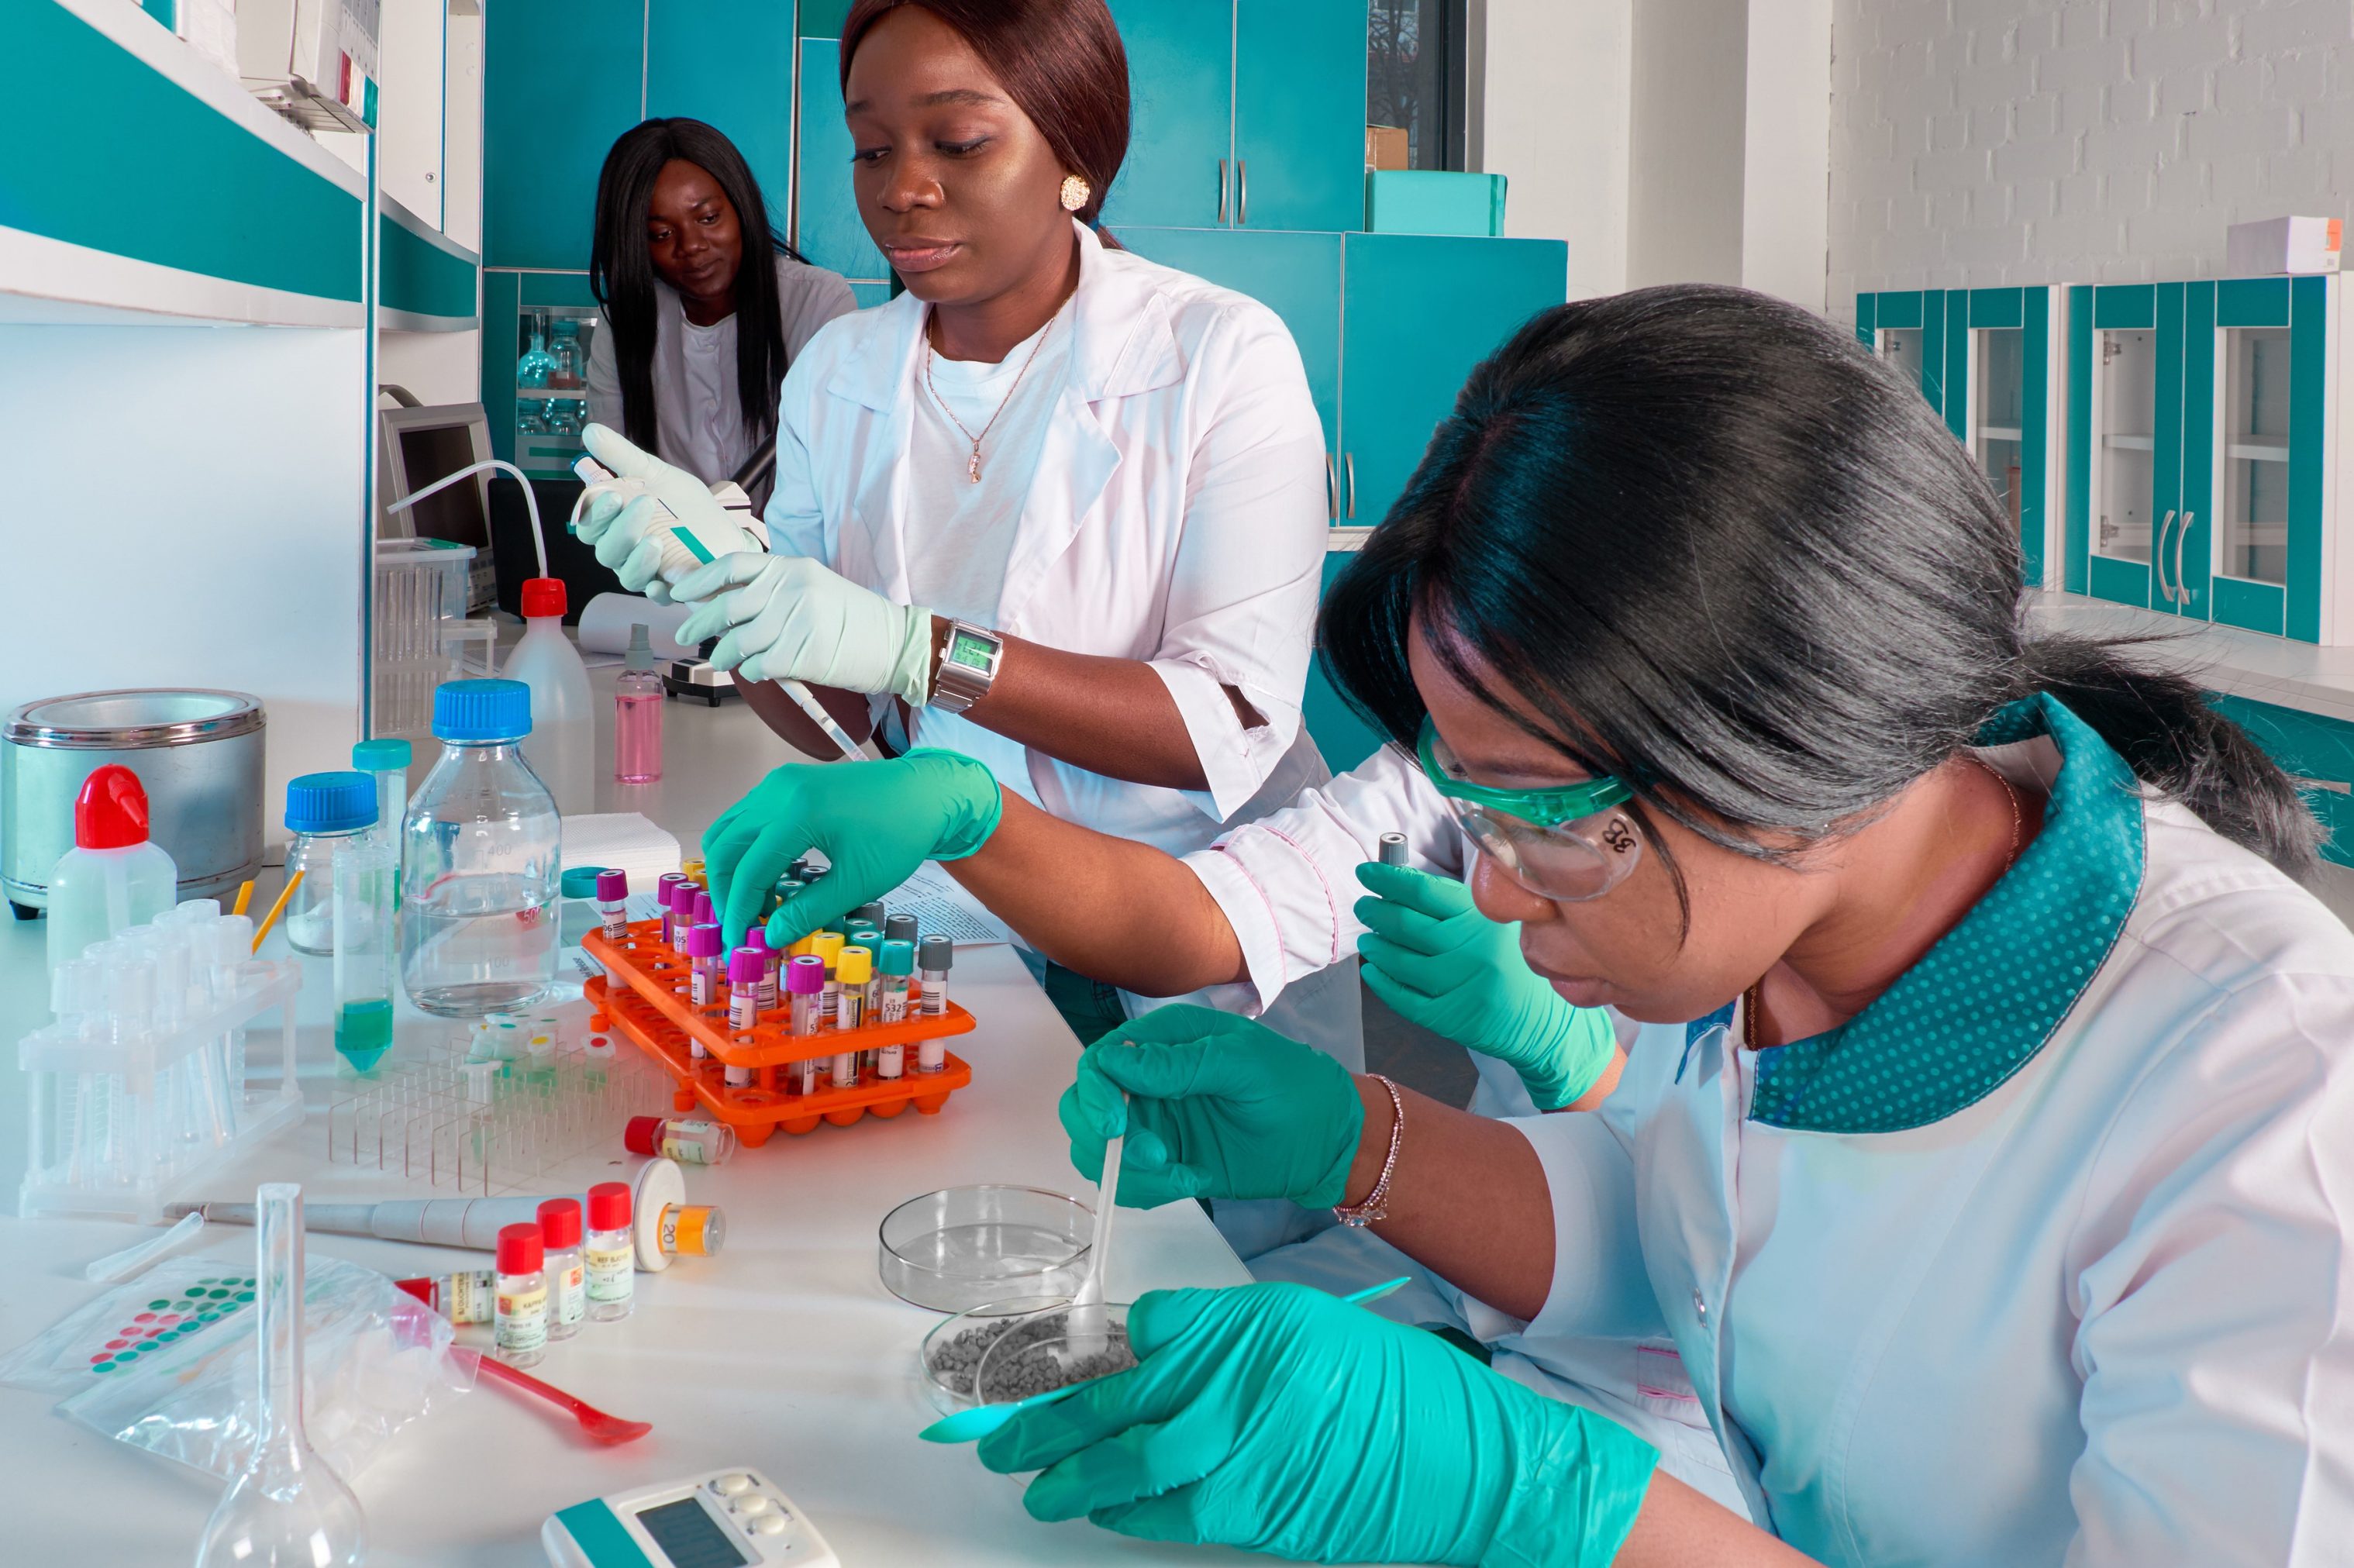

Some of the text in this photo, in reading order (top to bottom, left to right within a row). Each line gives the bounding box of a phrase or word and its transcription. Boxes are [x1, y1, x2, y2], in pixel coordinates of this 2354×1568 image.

[488, 843, 512, 856] 400
[488, 955, 509, 968] 100
[885, 1003, 901, 1012] 532
[663, 1224, 676, 1244] 20
